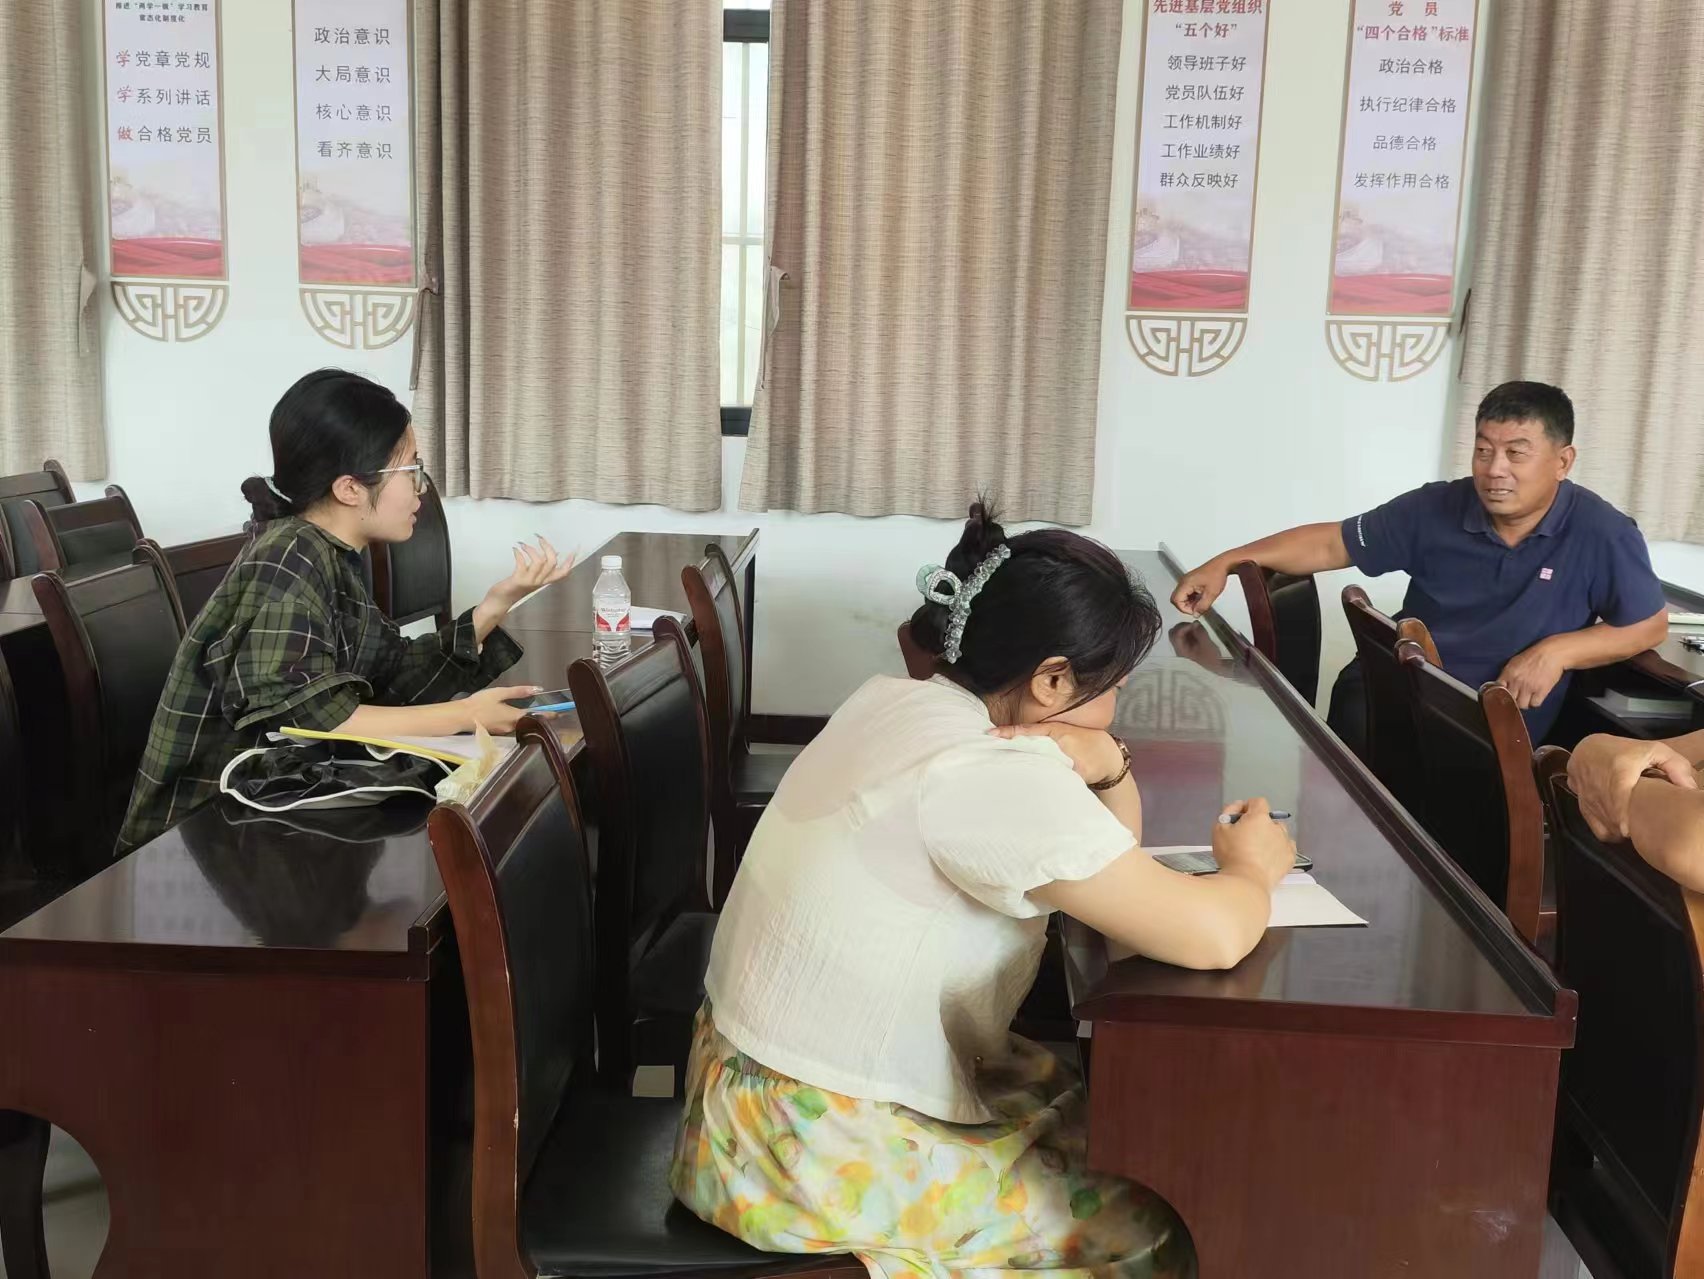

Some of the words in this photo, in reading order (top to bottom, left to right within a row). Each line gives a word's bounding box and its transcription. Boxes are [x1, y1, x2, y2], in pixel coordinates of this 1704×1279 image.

[1153, 0, 1263, 14] 先进基层党组织
[314, 26, 391, 48] 政治意识
[115, 49, 211, 70] 学党章党规
[1167, 54, 1247, 73] 领导班子好
[1378, 58, 1444, 75] 政治合格
[315, 64, 391, 85] 大局意识
[116, 85, 211, 106] 学系列讲话
[1164, 84, 1245, 102] 党员队伍好
[316, 103, 392, 122] 核心意识
[1359, 95, 1457, 114] 执行纪律合格
[1162, 113, 1243, 131] 工作机制好
[117, 125, 213, 144] 做合格党员
[1372, 134, 1437, 152] 品德合格
[317, 140, 393, 160] 看齐意识
[1160, 142, 1241, 160] 工作业绩好
[1159, 171, 1239, 189] 群众反映好
[1353, 172, 1450, 190] 发挥作用合格
